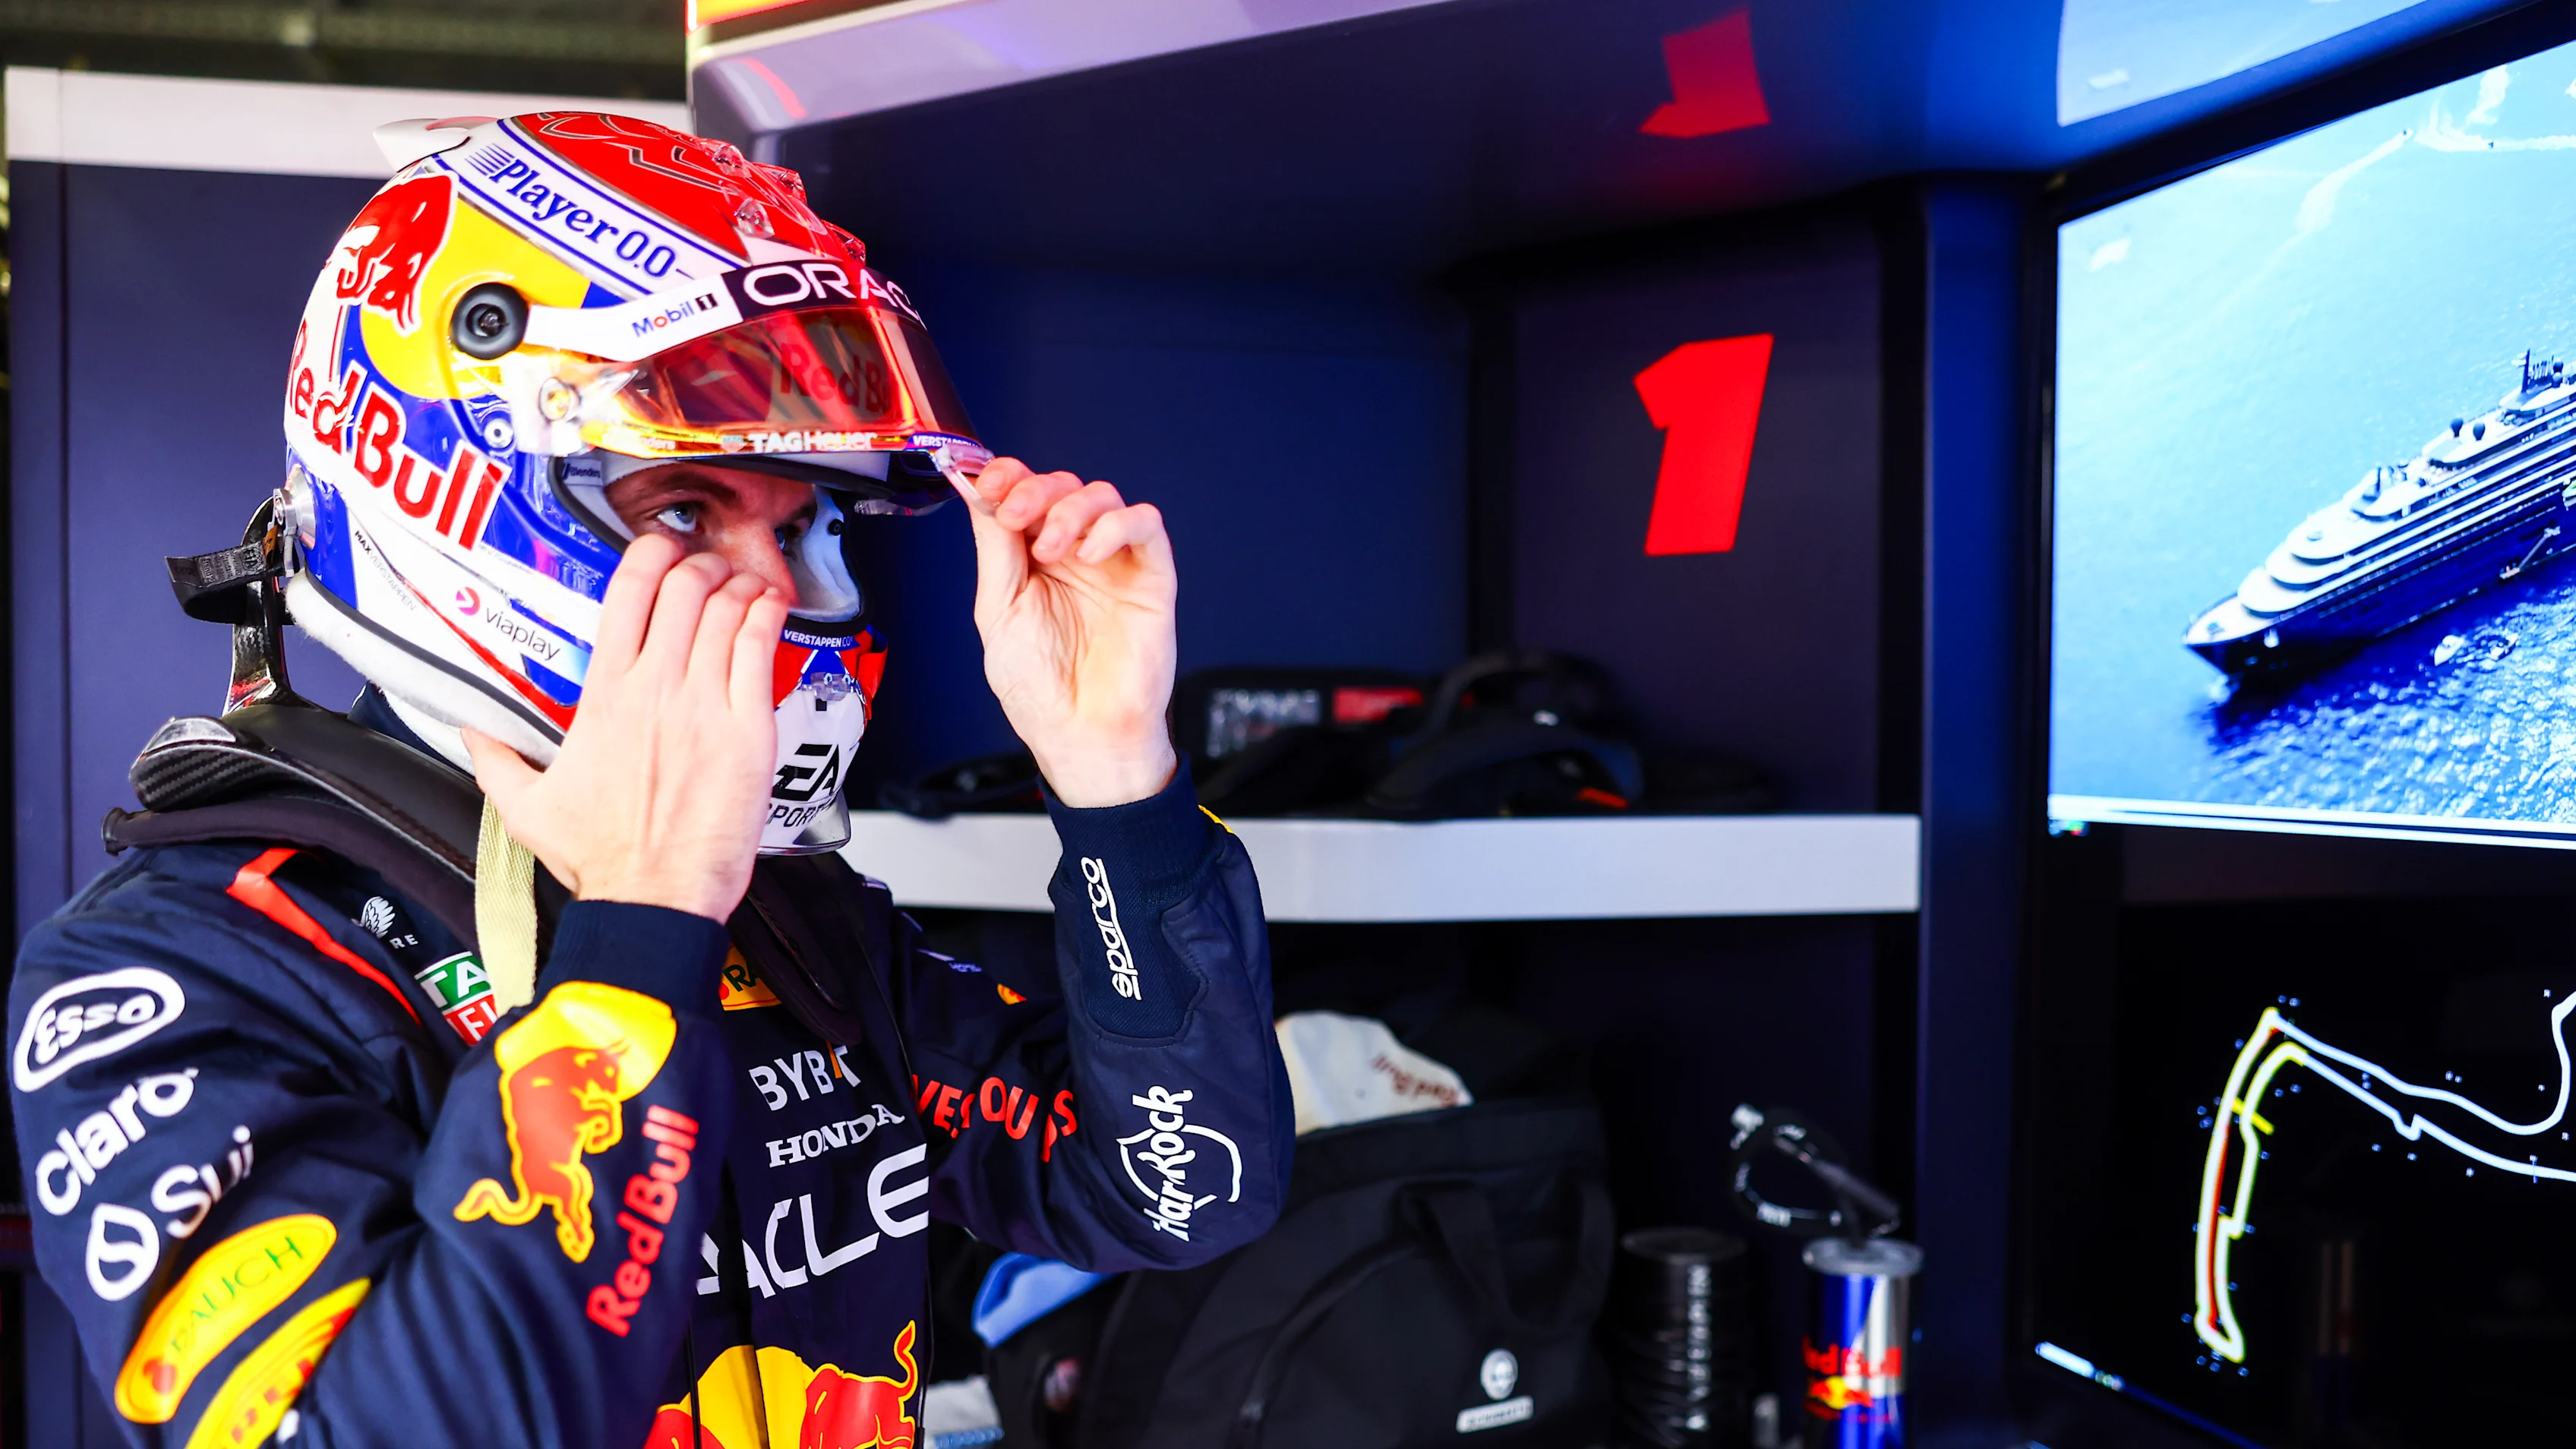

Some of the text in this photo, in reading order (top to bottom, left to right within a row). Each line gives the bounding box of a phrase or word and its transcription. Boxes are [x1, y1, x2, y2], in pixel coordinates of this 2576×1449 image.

[490, 159, 677, 278] Player 0.0
[632, 294, 716, 337] Mobil 1
[743, 263, 927, 330] ORAC
[355, 391, 505, 551] Bull
[1634, 333, 1774, 556] 1
[486, 608, 560, 661] viaplay
[771, 743, 839, 802] EA
[1081, 857, 1141, 1000] sparco
[420, 960, 490, 1009] TA
[766, 1103, 905, 1168] HONDA
[1132, 1086, 1196, 1179] Rock
[586, 1104, 699, 1337] Red Bull
